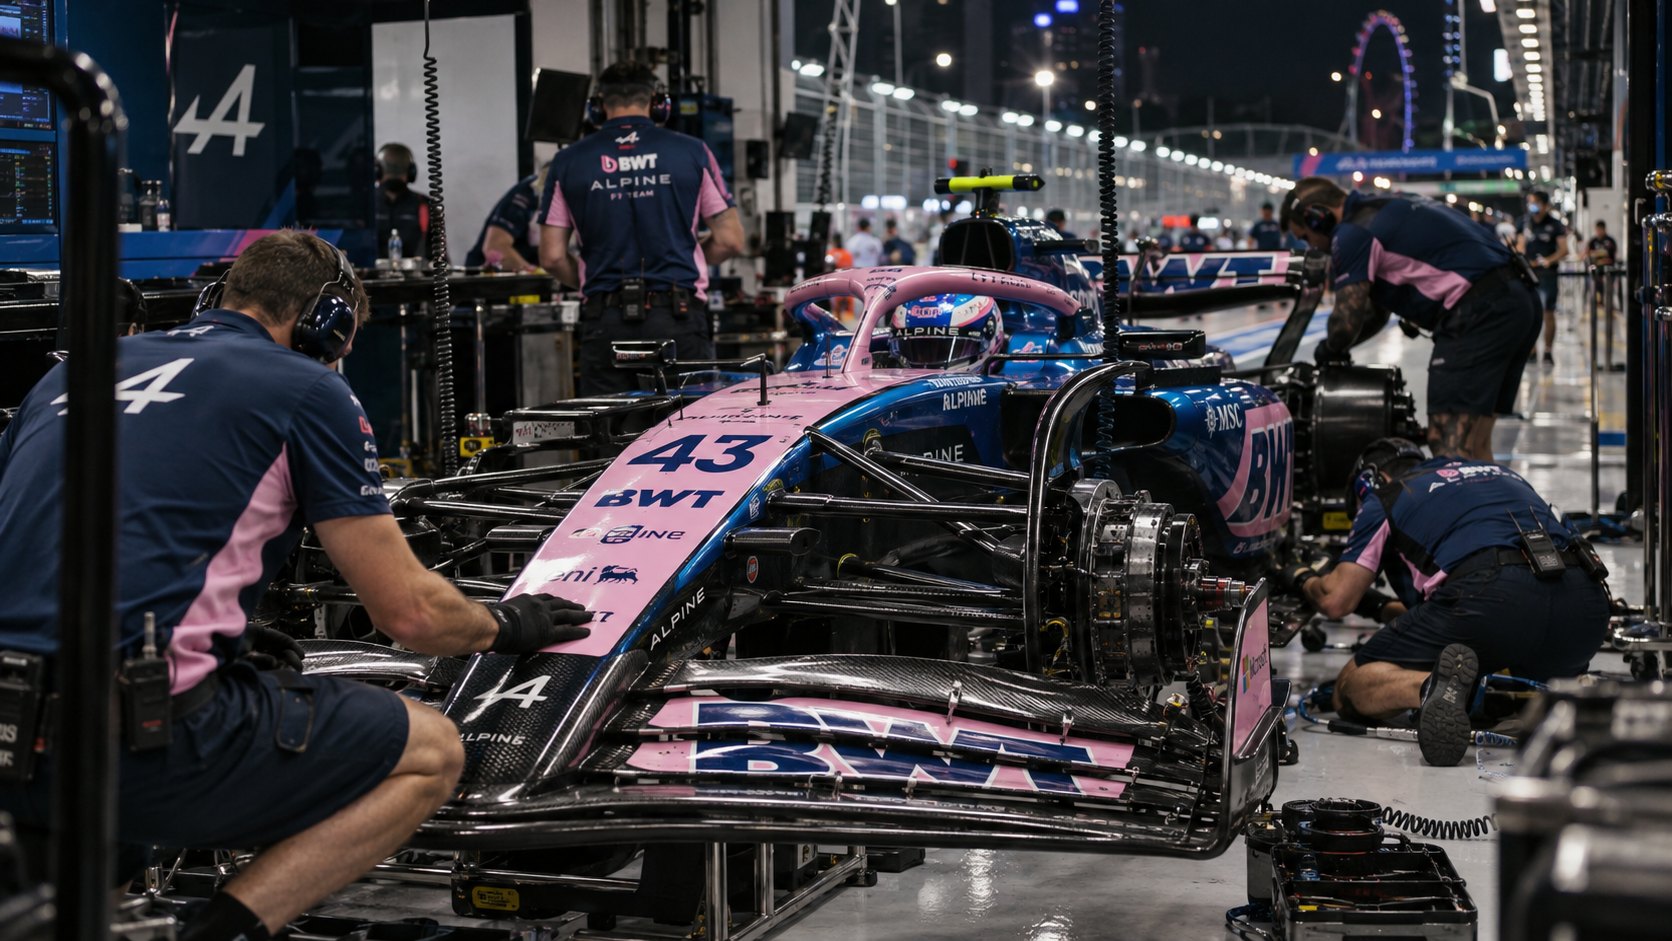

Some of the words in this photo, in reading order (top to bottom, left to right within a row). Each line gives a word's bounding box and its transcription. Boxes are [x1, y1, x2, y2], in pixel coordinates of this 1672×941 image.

[591, 174, 671, 191] ALPINE
[627, 190, 654, 199] TEAM
[896, 326, 959, 337] ALPINE
[1218, 402, 1243, 431] MSC
[627, 434, 774, 473] 43
[594, 489, 725, 508] BWT
[545, 566, 598, 583] eni
[650, 586, 706, 651] ALPINE
